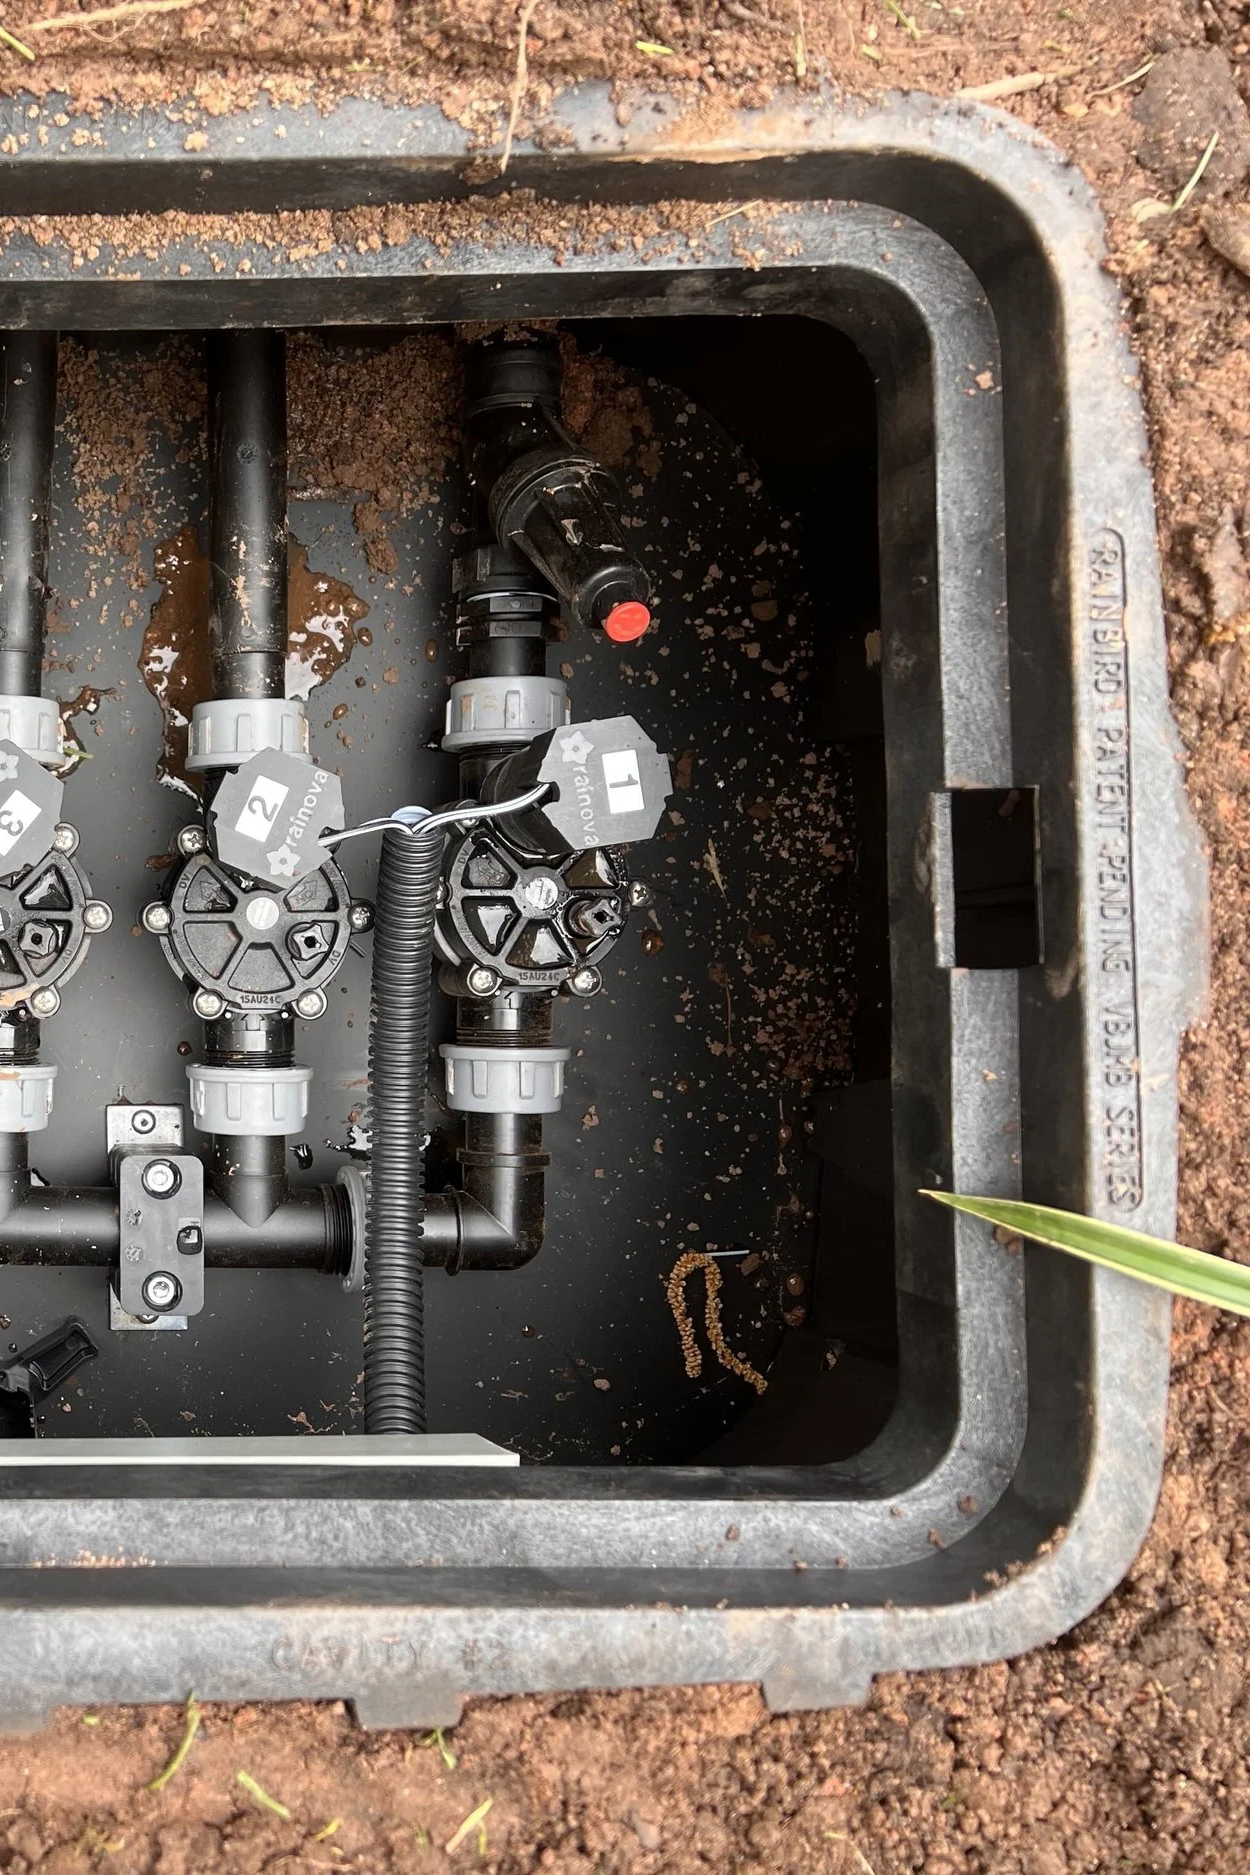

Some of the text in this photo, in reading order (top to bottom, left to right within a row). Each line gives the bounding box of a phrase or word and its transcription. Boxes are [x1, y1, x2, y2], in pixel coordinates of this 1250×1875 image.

[609, 773, 639, 789] 1
[1096, 726, 1127, 834] PATENT
[247, 794, 279, 823] 2
[284, 769, 330, 848] rainova
[572, 765, 600, 847] rainova
[458, 849, 470, 864] DV
[179, 874, 190, 889] DV
[1099, 854, 1131, 974] PENDING
[329, 950, 341, 966] DV
[518, 971, 561, 982] 15AU24C
[239, 994, 281, 1005] 15AU24C
[1105, 1104, 1139, 1205] SERIES
